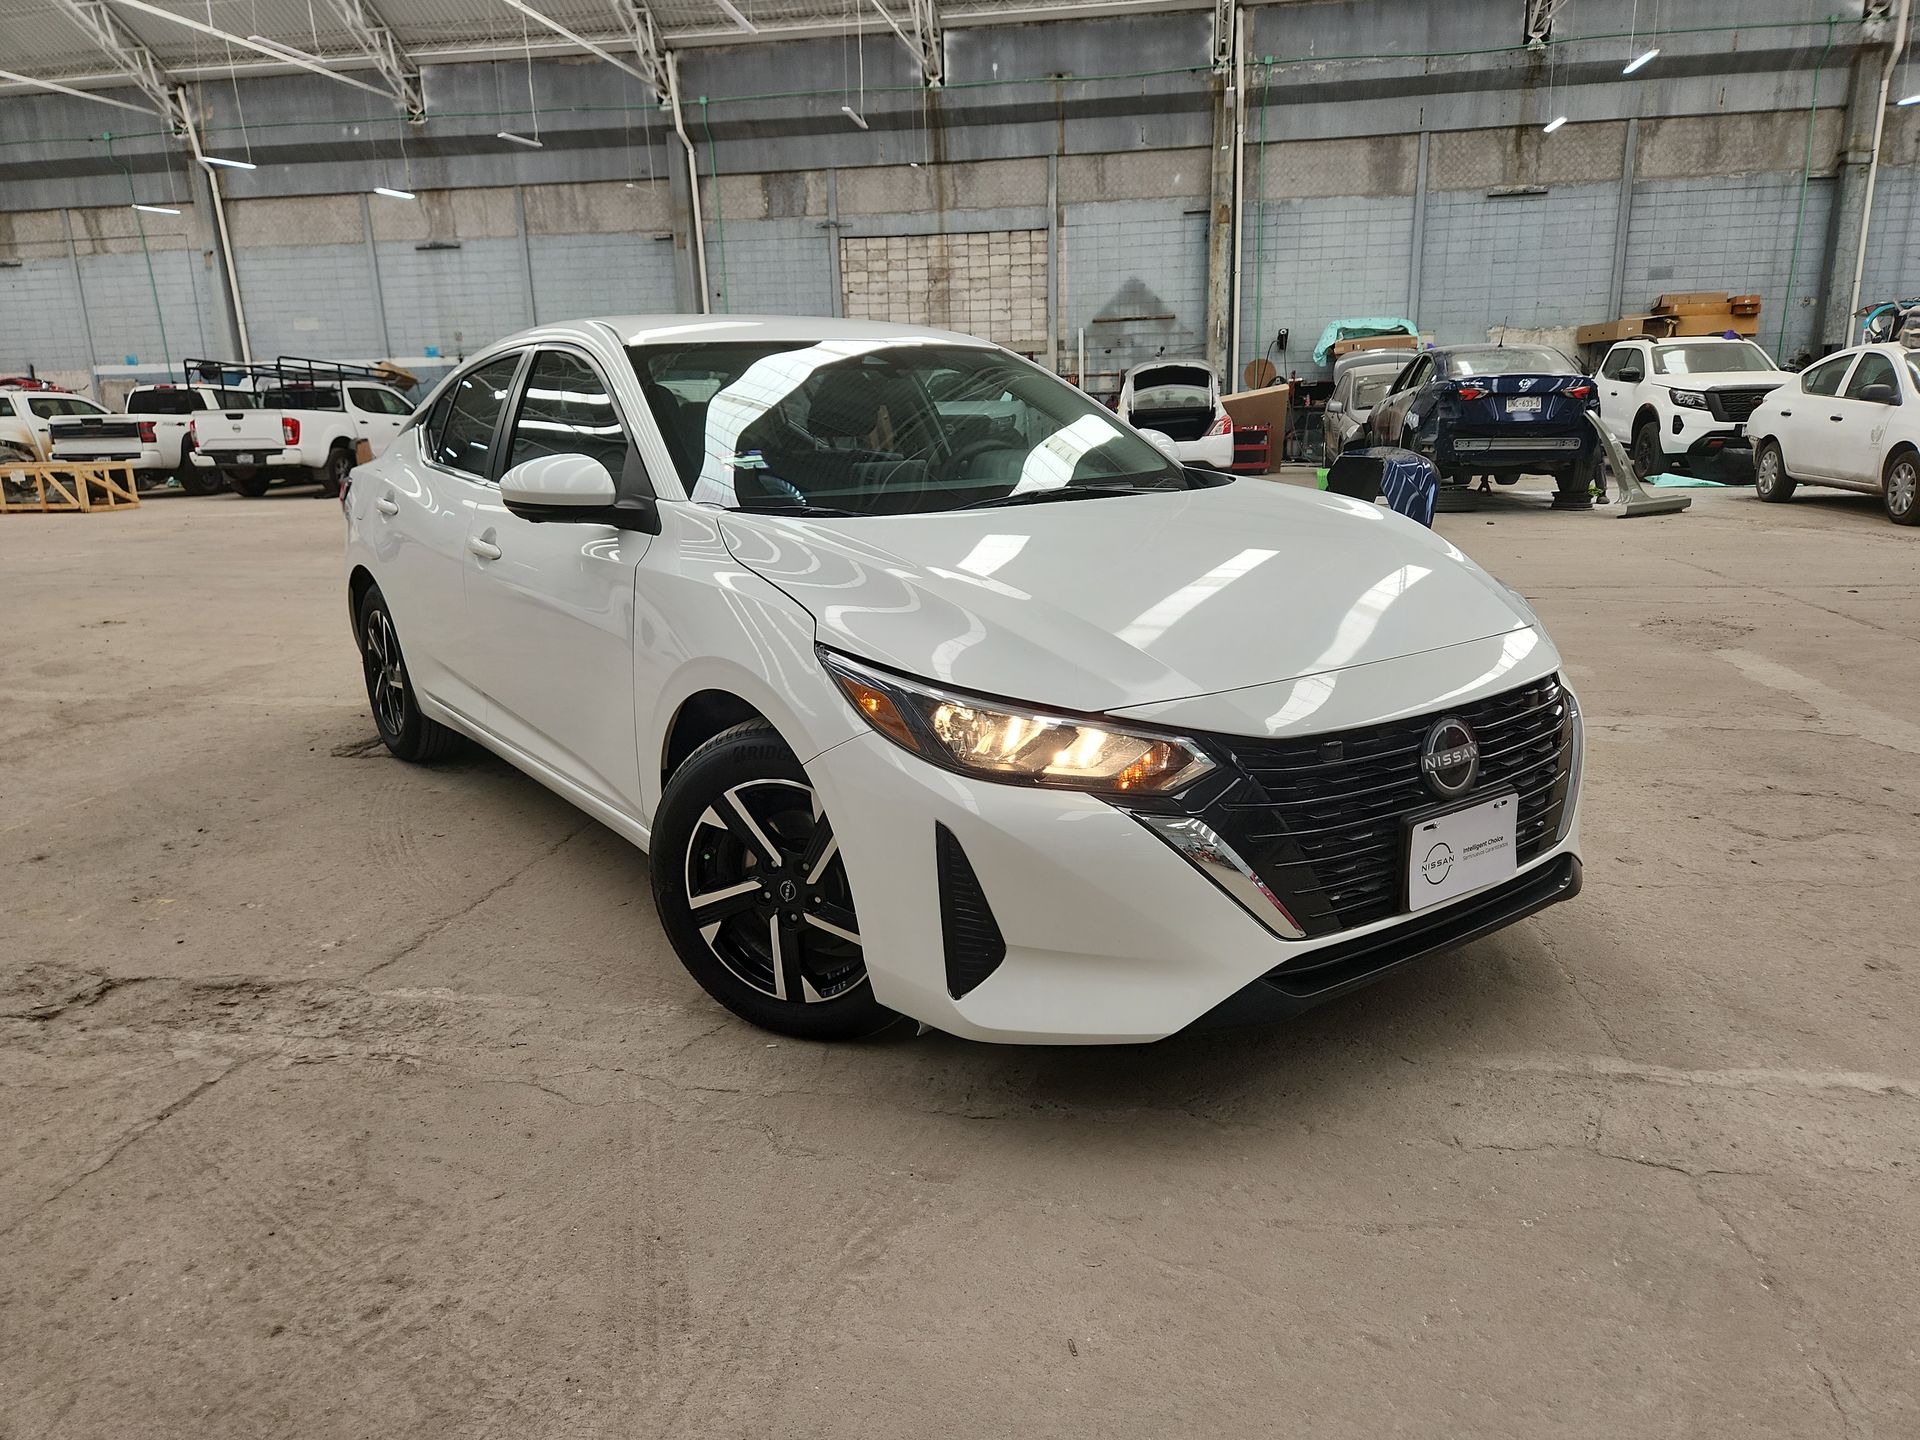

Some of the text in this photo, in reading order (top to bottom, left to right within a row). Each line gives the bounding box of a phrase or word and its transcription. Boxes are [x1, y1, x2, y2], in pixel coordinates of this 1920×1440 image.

[1424, 742, 1478, 770] NISSAN
[1463, 835, 1504, 854] Intelligent Choice
[1421, 855, 1455, 873] NISSAN
